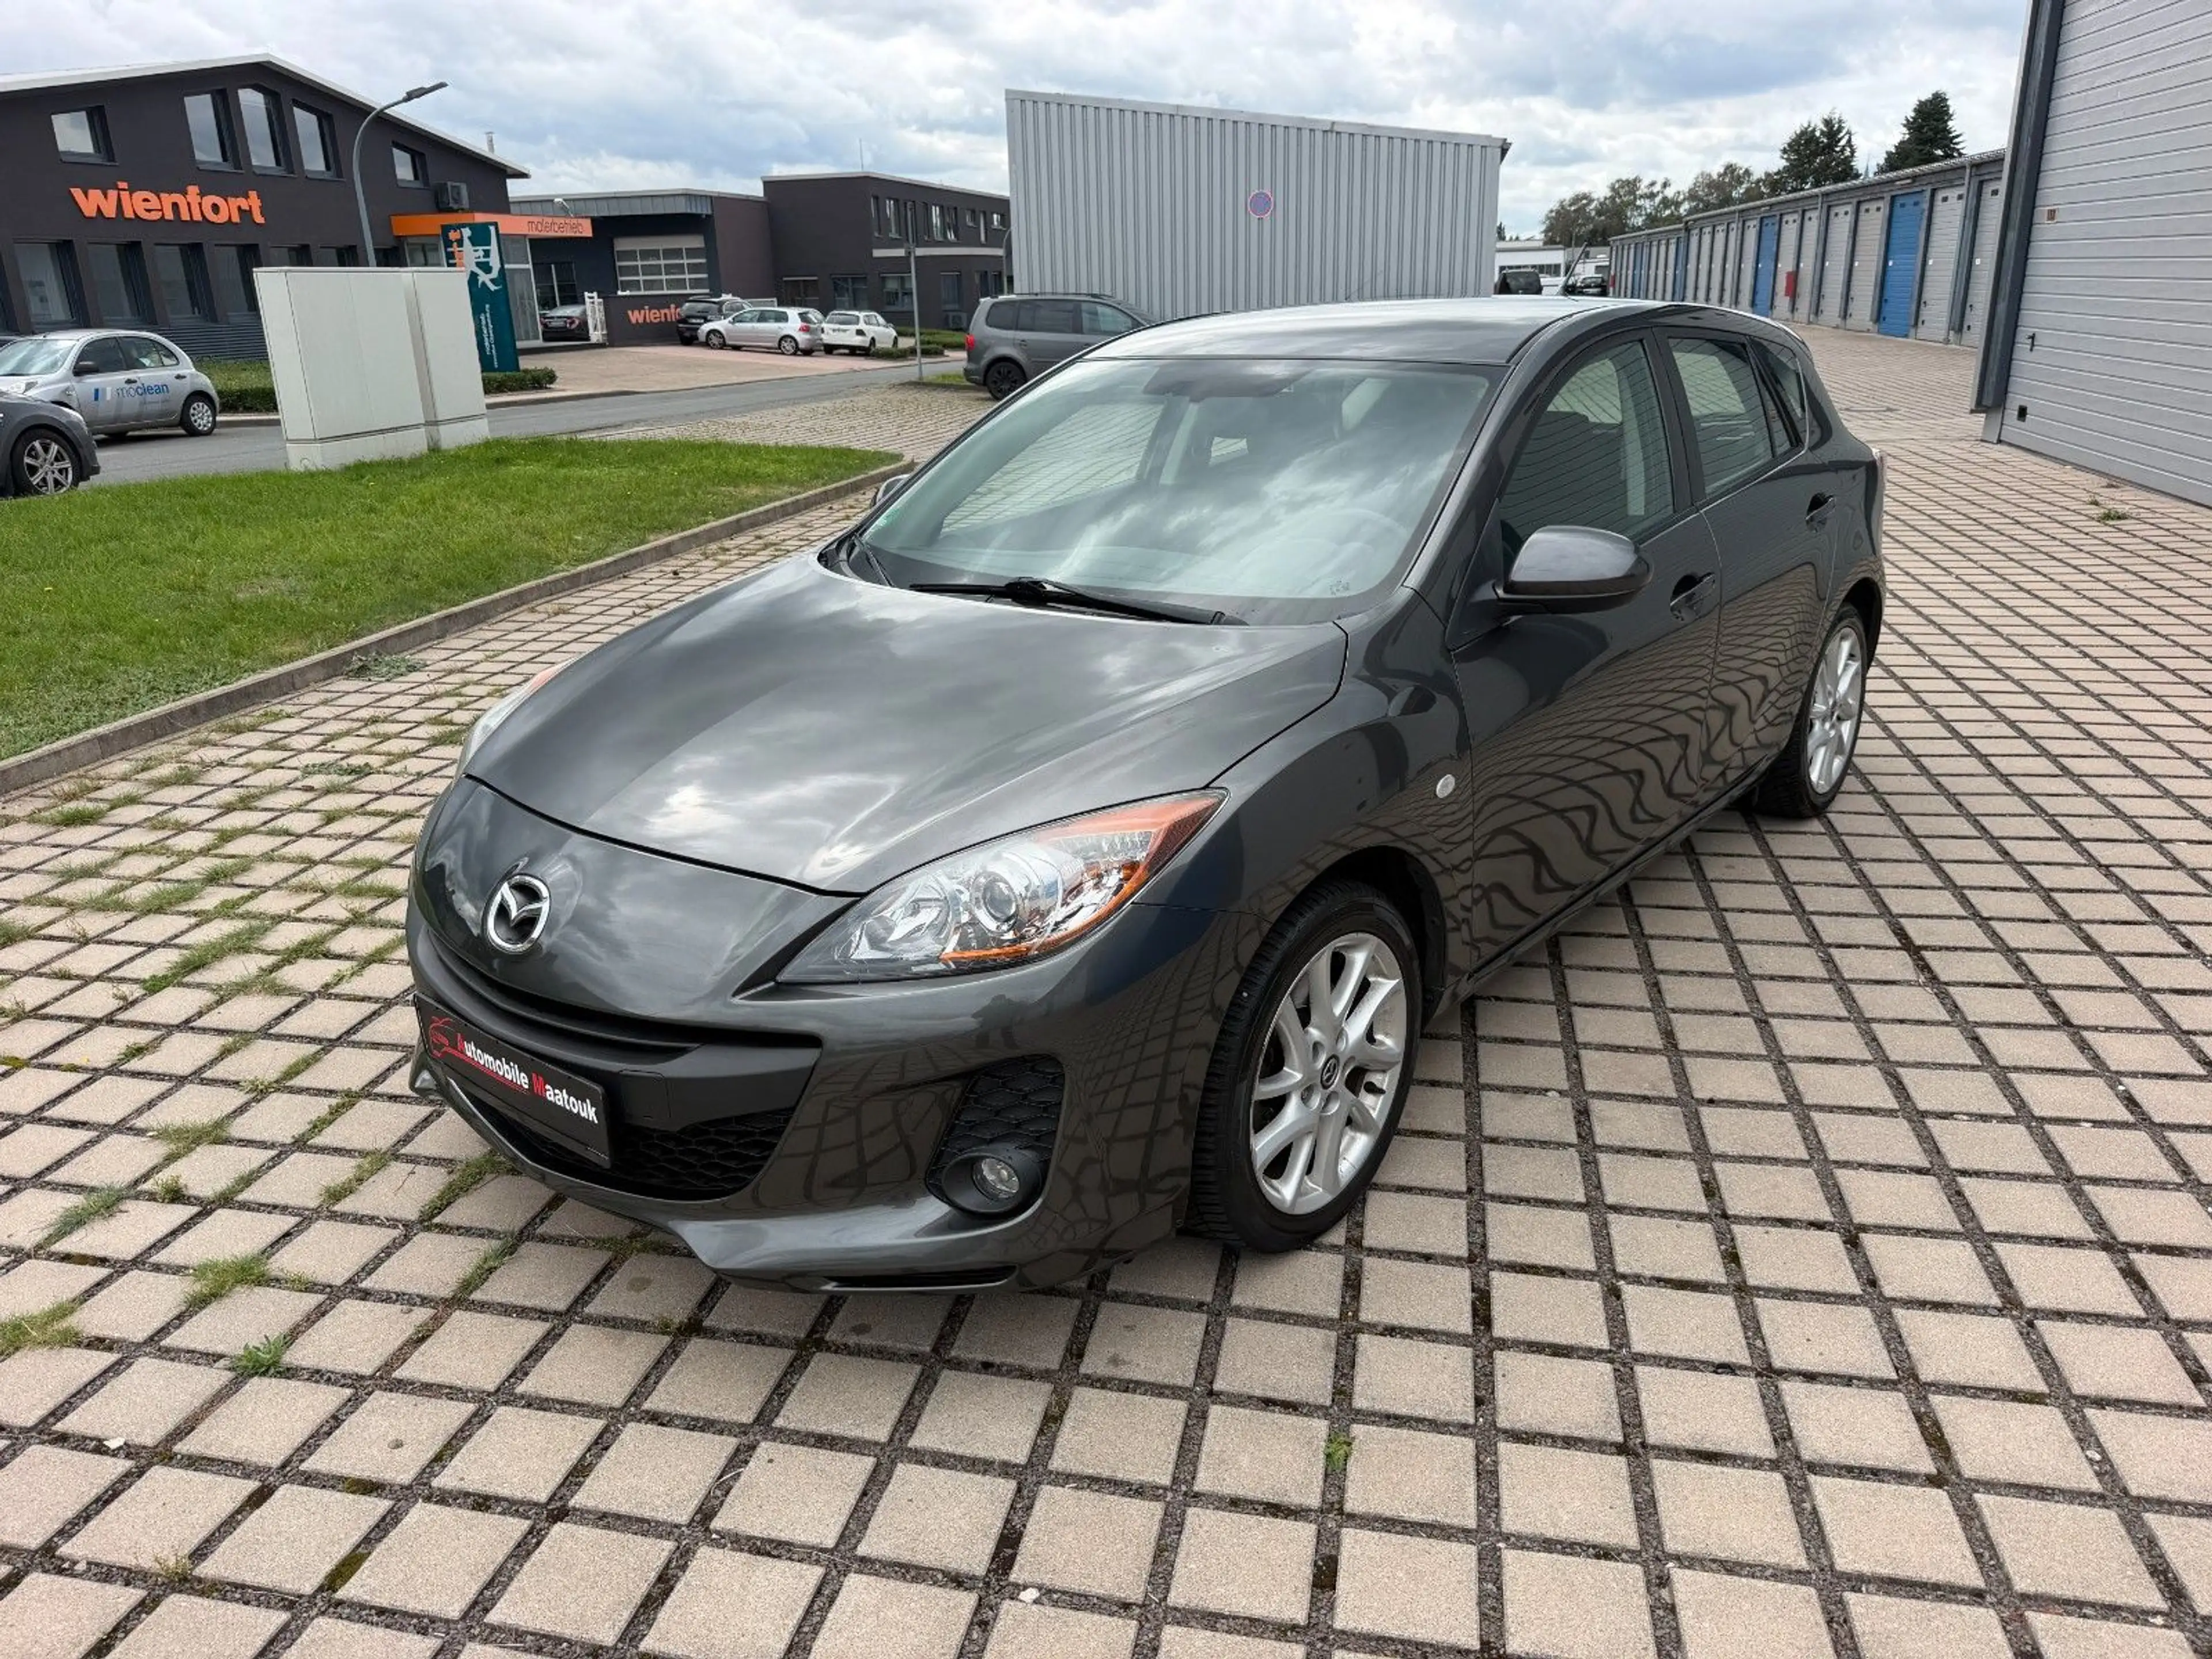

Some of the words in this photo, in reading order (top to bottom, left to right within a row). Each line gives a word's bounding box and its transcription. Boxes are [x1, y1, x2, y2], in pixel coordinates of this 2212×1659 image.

[69, 181, 266, 225] wienfort
[116, 383, 170, 398] moclean
[456, 1033, 529, 1089] Automobile
[531, 1071, 599, 1124] Maatouk
